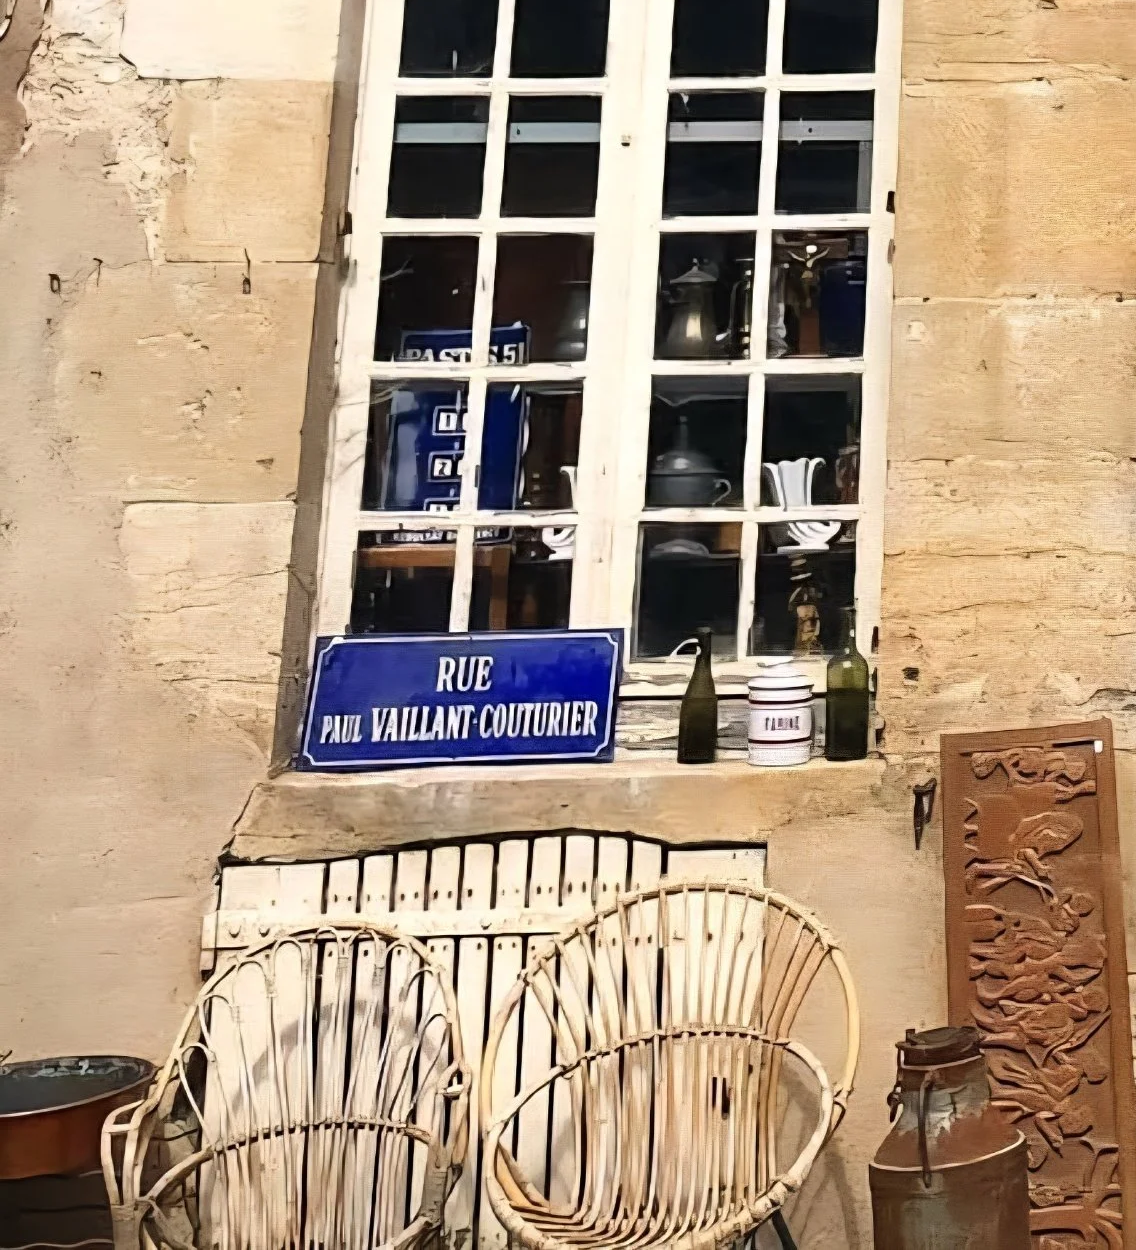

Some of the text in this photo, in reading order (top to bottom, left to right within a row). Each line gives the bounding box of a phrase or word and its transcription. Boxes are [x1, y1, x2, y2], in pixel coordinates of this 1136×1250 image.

[404, 344, 499, 366] PASTS
[436, 656, 494, 692] RUE
[319, 714, 363, 744] PAUL
